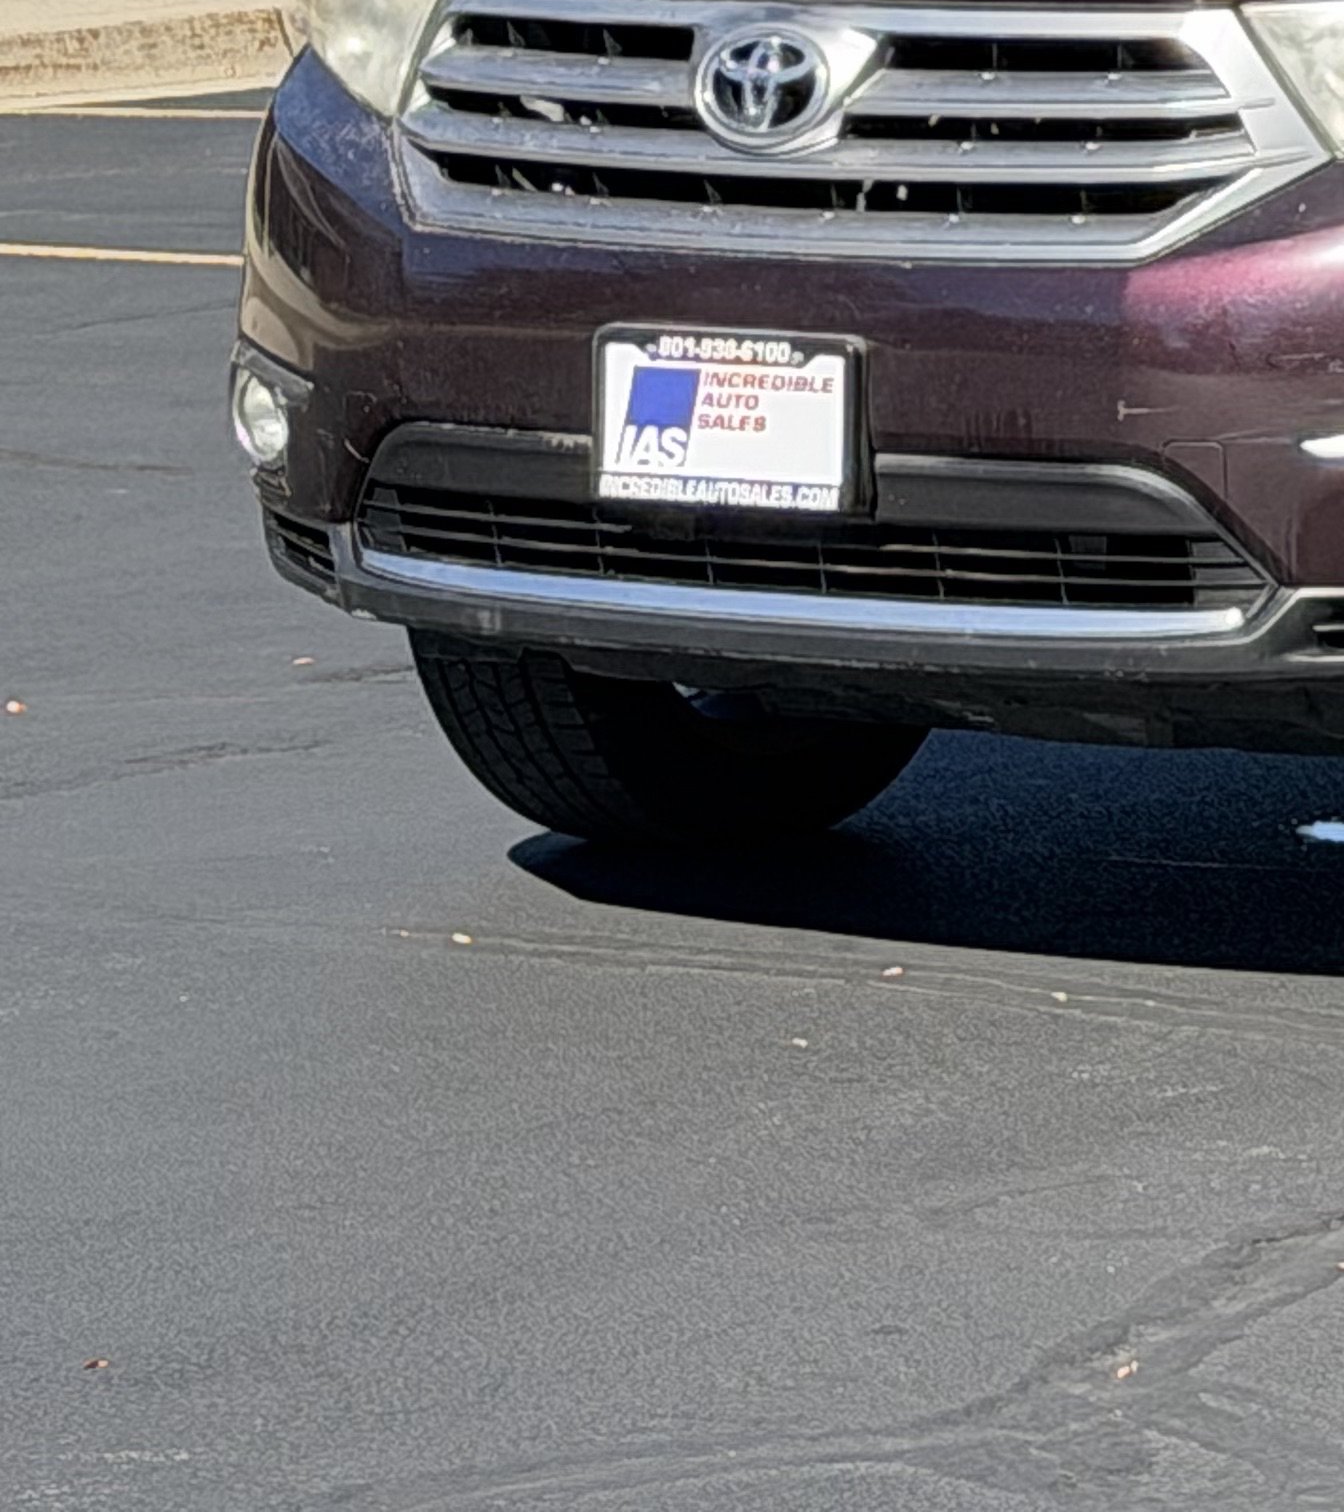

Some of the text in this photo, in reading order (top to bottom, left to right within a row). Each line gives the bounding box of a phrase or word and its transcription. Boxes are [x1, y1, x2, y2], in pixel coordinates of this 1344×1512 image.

[703, 371, 835, 393] INCREDIBLE
[701, 391, 760, 410] AUTO
[697, 413, 767, 432] SALES
[618, 423, 689, 467] IAS
